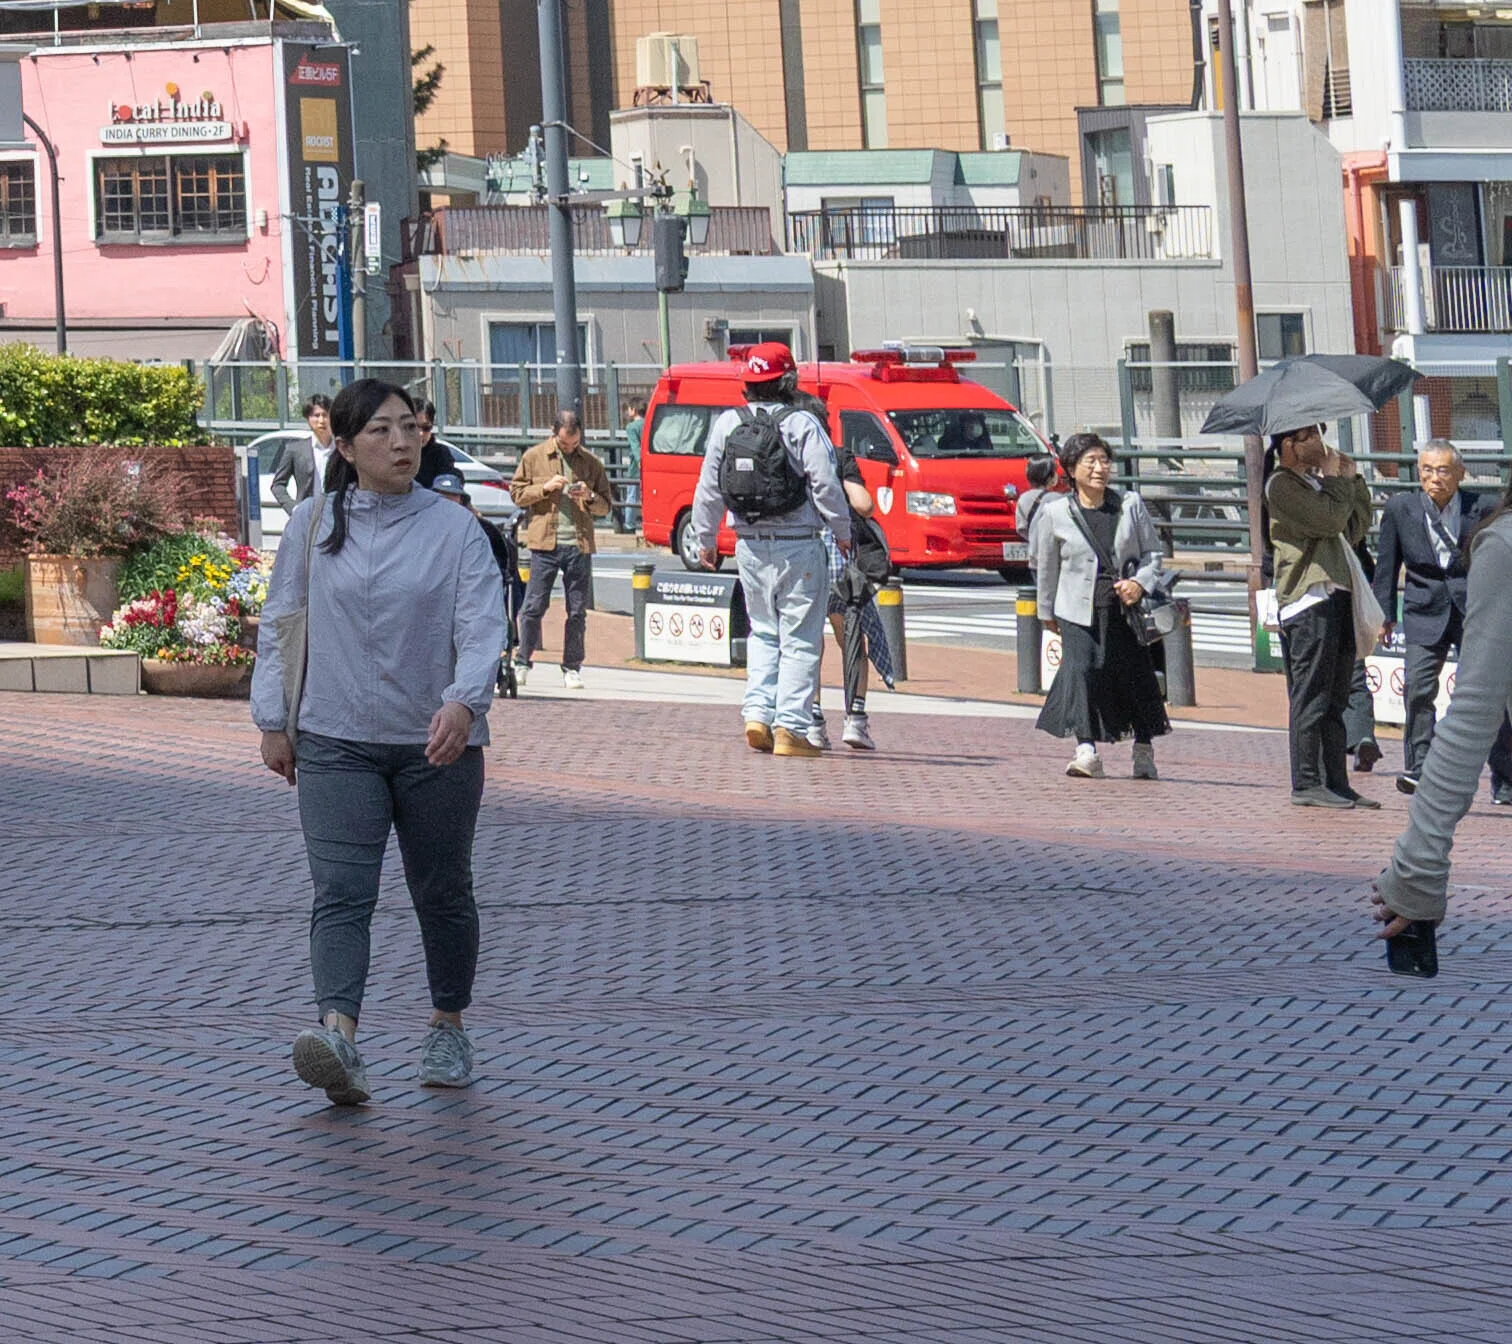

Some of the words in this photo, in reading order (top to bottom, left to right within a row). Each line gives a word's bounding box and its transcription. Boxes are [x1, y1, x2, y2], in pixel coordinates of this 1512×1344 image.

[108, 95, 159, 121] Local
[105, 128, 133, 140] INDIA
[136, 127, 169, 139] CURRY
[309, 246, 317, 296] Financial
[311, 299, 319, 350] Planning
